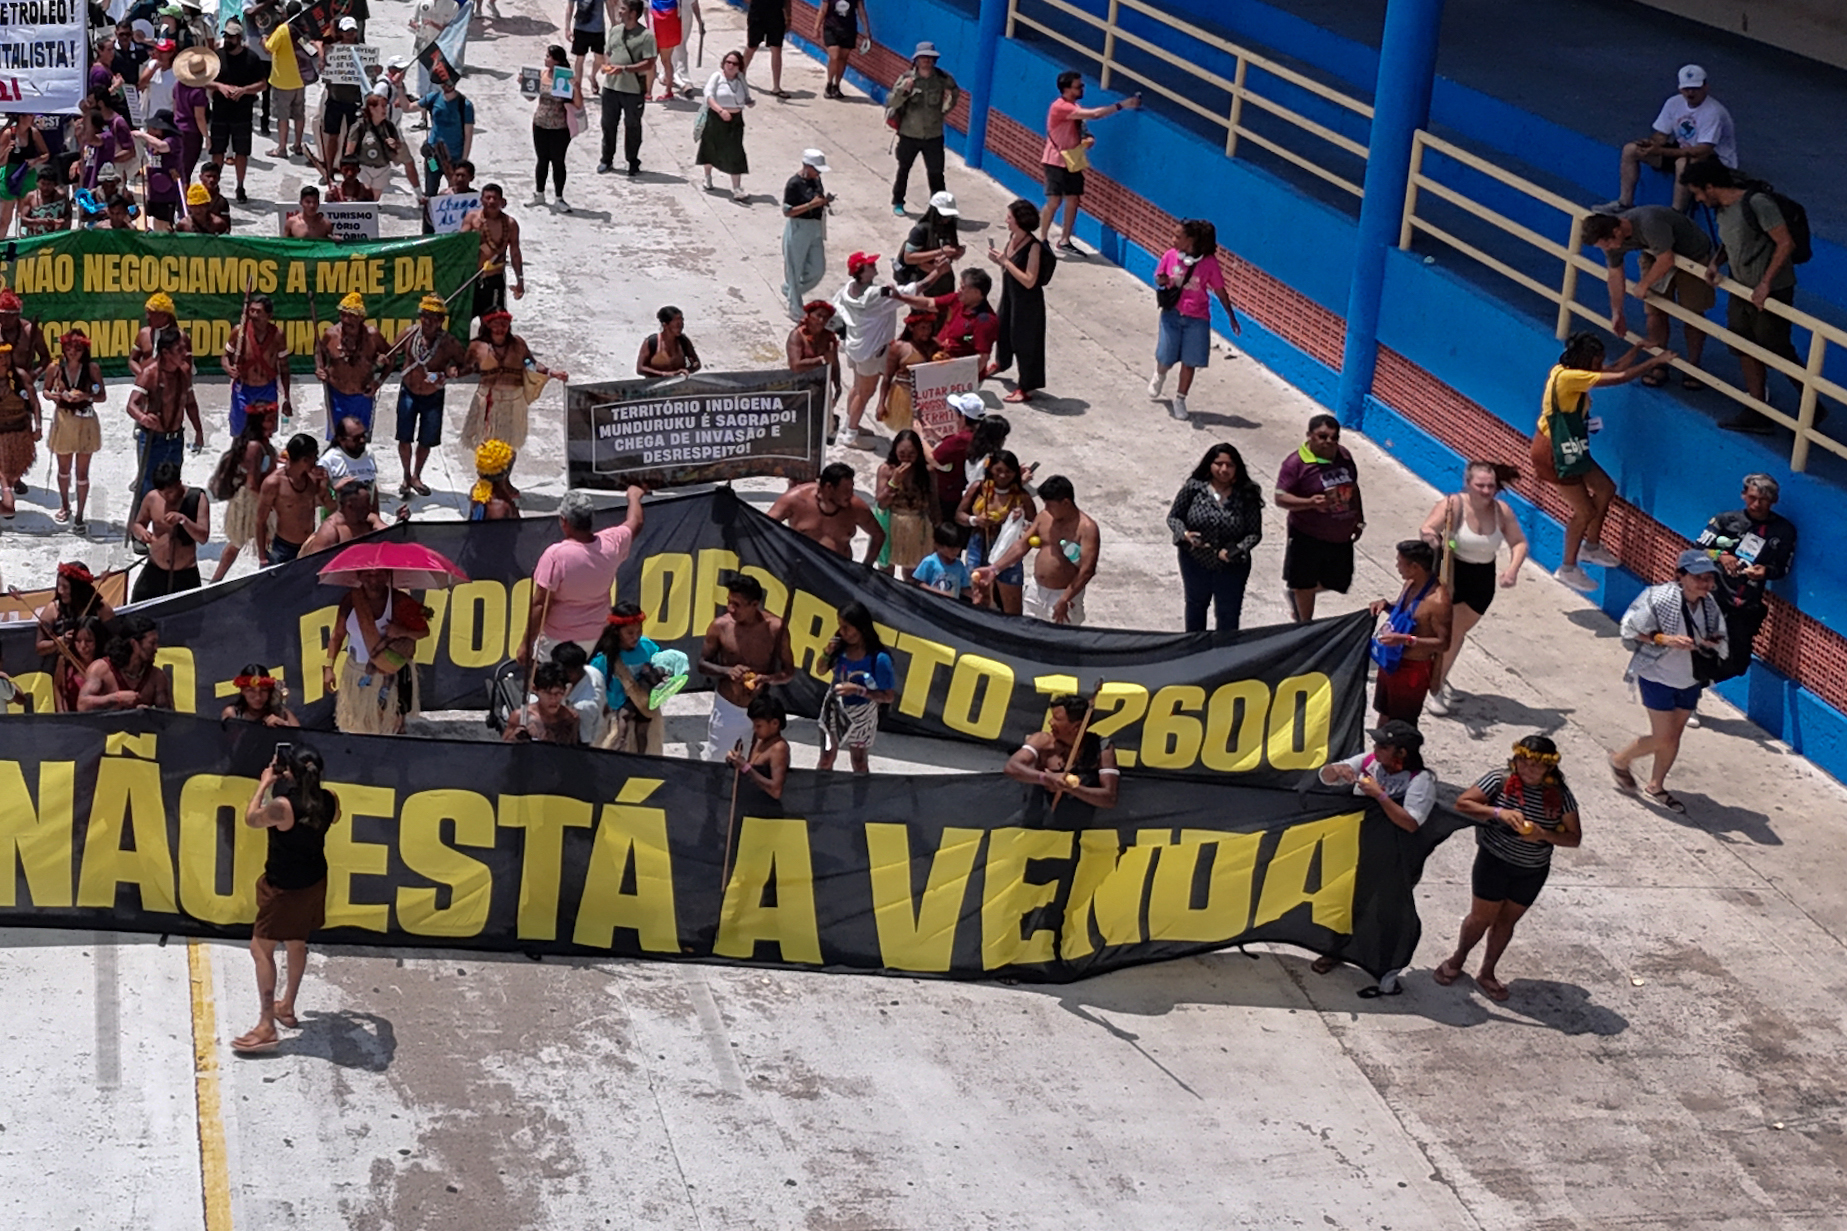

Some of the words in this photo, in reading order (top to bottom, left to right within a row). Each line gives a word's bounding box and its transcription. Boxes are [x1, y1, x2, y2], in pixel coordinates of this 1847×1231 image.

[326, 210, 373, 220] TURISMO
[15, 248, 76, 294] NÃO
[82, 253, 278, 294] NEGOCIAMOS
[286, 260, 309, 293] A
[315, 251, 387, 295] MÃE
[393, 254, 434, 293] DA
[611, 399, 700, 421] TERRITÓRIO
[705, 395, 784, 413] INDÍGENA
[599, 415, 696, 439] MUNDURUKU
[701, 411, 710, 428] É
[715, 409, 797, 428] SAGRADO!
[614, 431, 666, 452] CHEGA
[670, 431, 690, 445] DE
[695, 424, 767, 444] INVASÃO
[771, 424, 781, 438] E
[642, 444, 752, 464] DESRESPEITO!
[1034, 671, 1333, 772] 12600
[320, 778, 680, 953] ESTÁ
[713, 818, 824, 965] A
[865, 810, 1365, 971] VENDA
